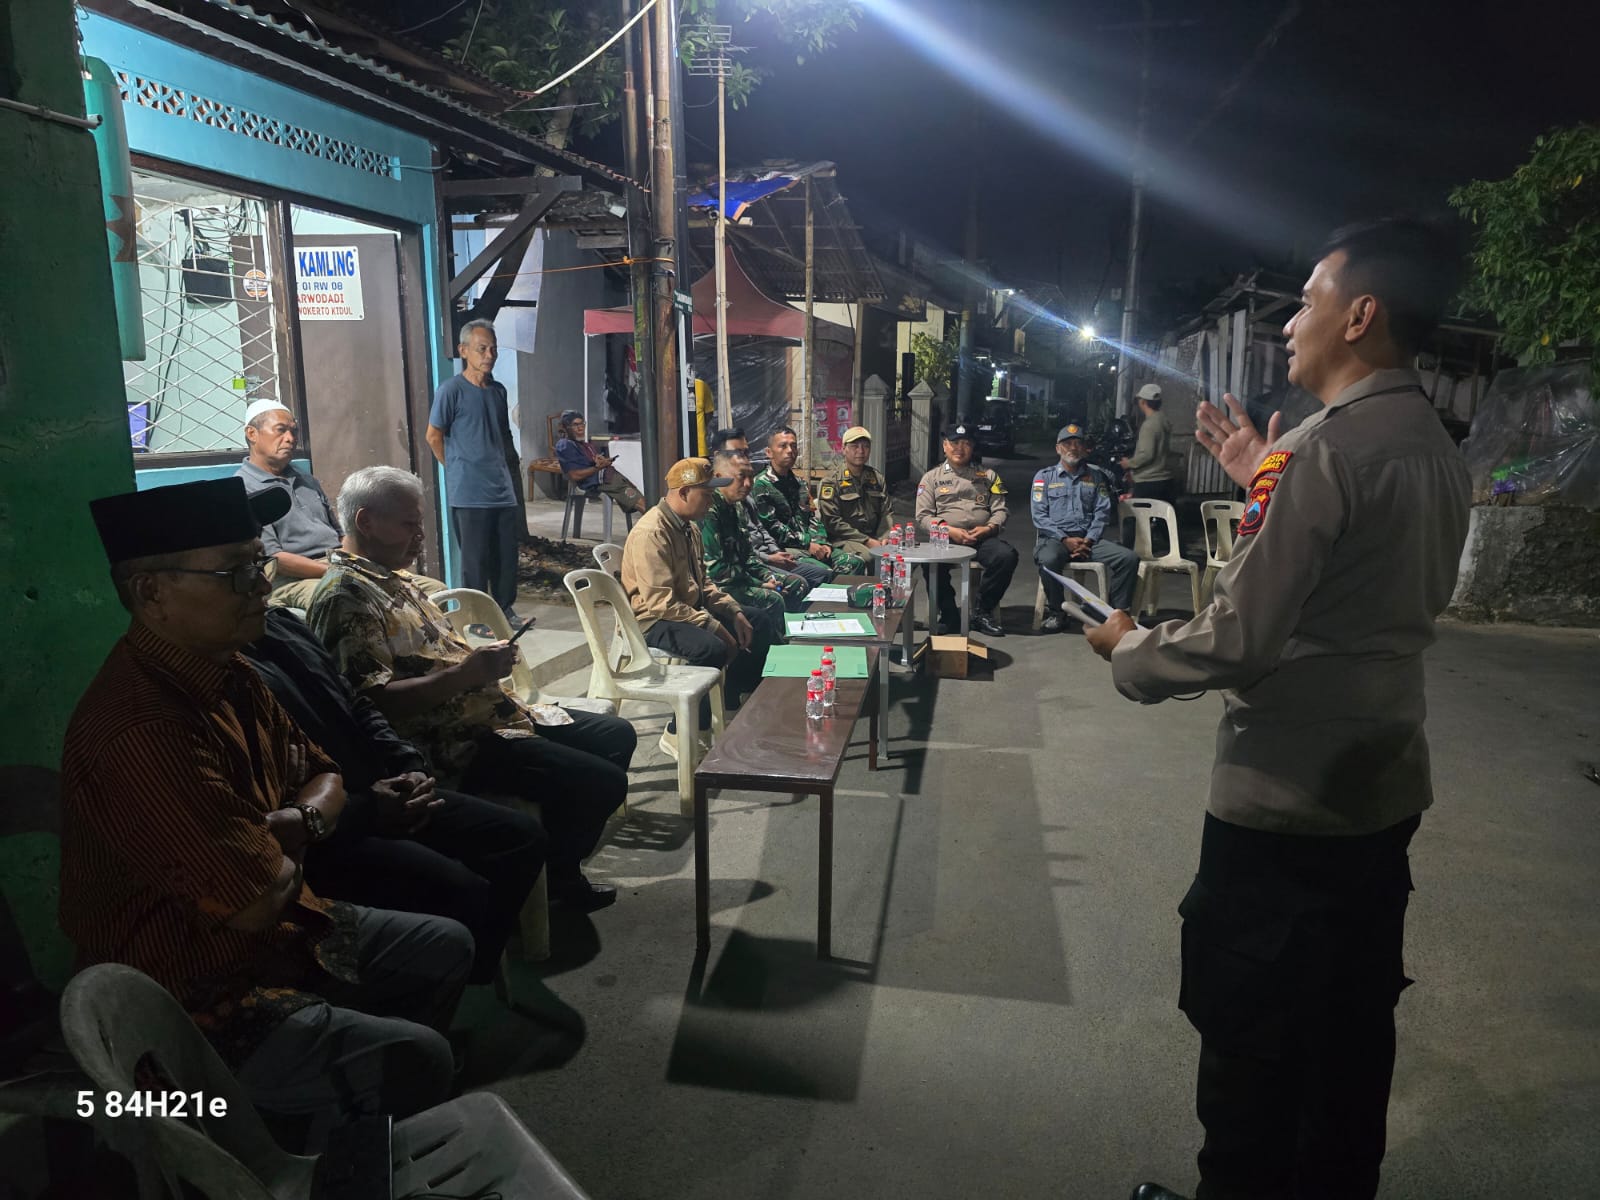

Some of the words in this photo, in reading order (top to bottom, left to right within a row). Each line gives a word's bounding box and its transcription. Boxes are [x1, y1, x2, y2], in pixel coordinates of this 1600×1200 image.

[298, 251, 355, 277] KAMLING
[313, 281, 328, 291] RW
[331, 281, 343, 291] 08
[296, 293, 345, 304] ARWODADI
[297, 306, 330, 315] WOKERTO
[331, 306, 353, 315] KIDUL
